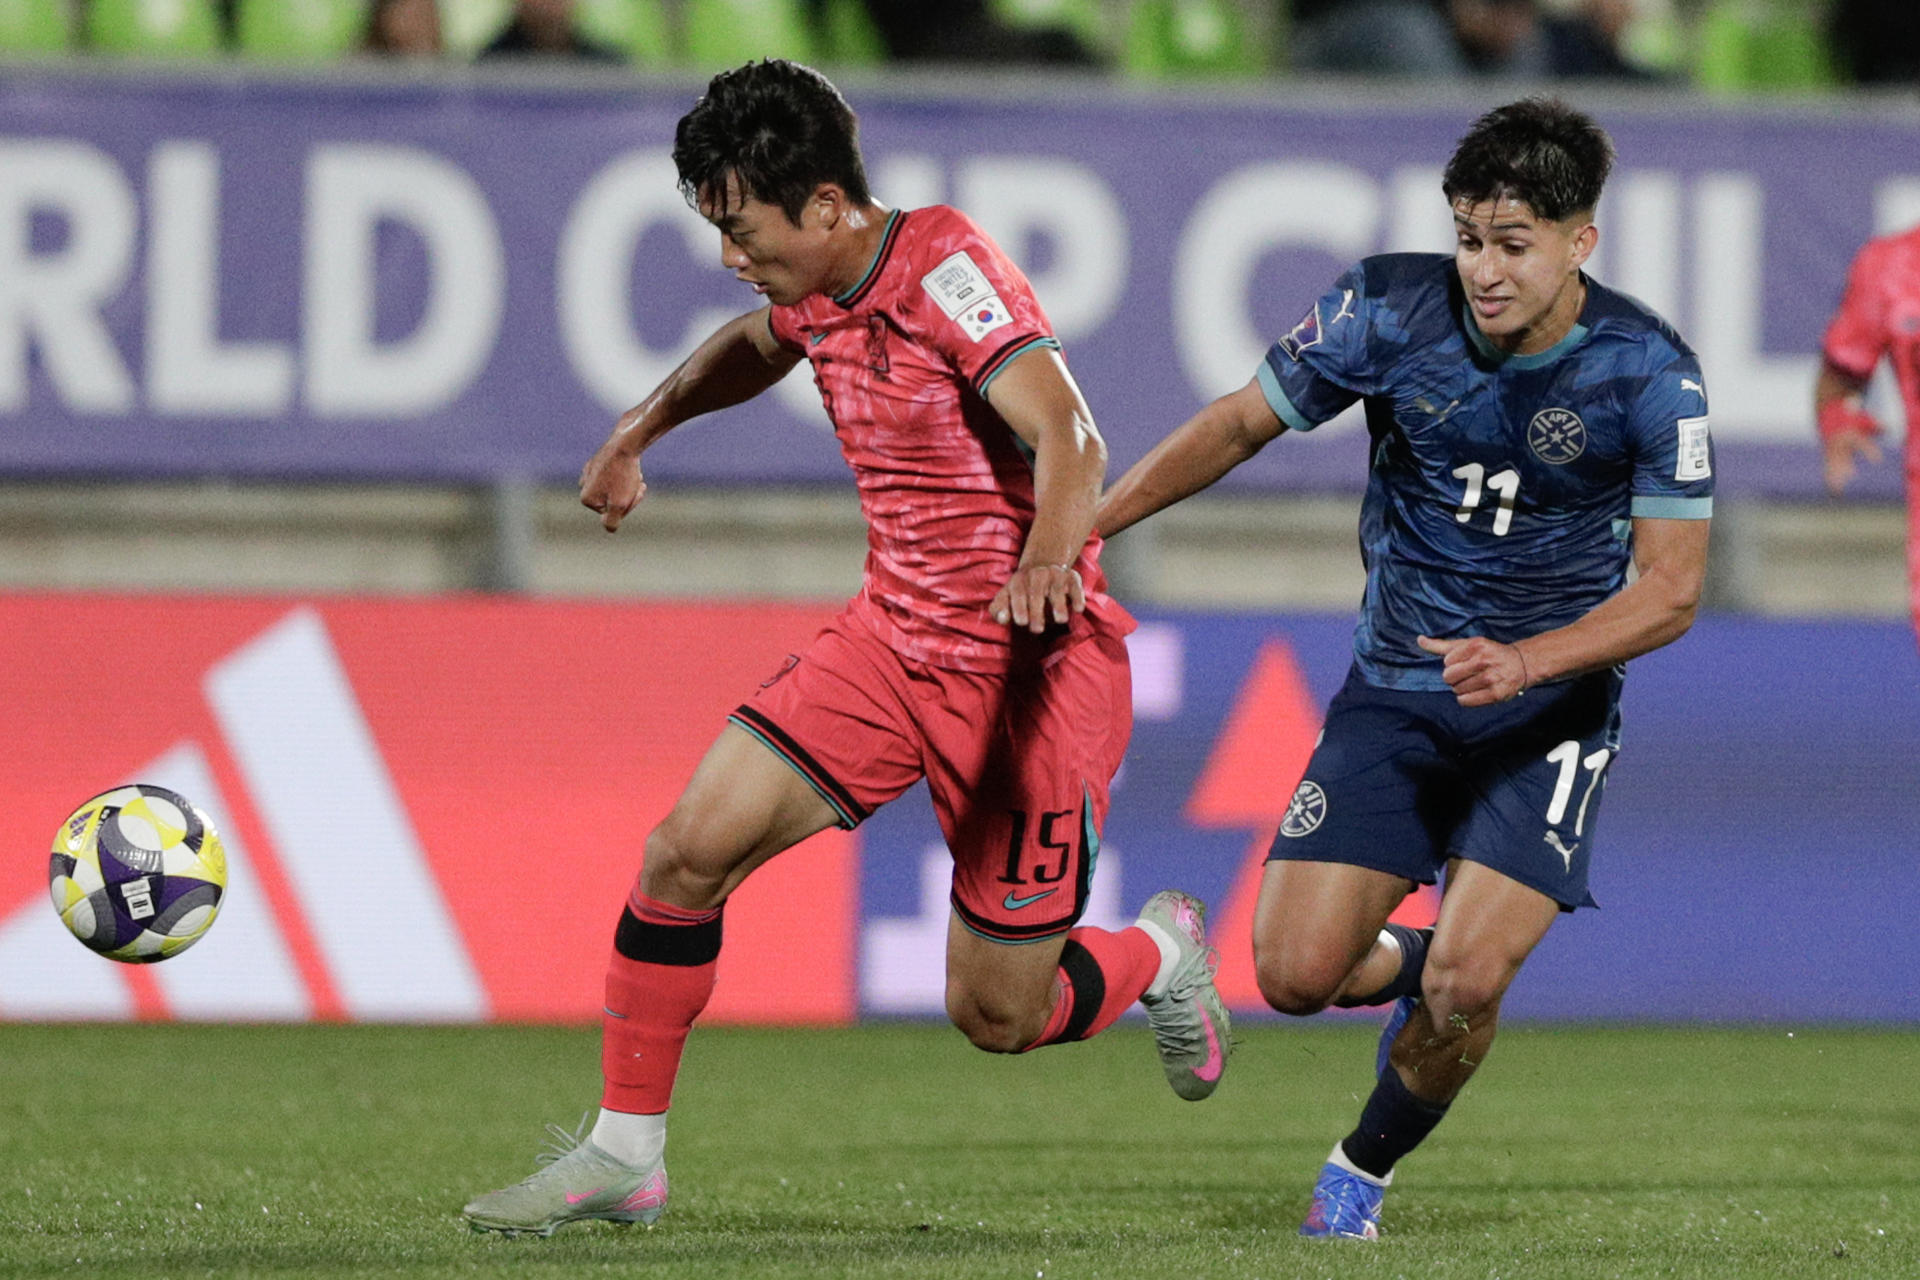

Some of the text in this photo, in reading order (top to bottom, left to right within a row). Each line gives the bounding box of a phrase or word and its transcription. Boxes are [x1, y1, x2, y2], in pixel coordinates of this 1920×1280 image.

[555, 143, 1134, 432] CP
[1549, 412, 1568, 423] APF
[1452, 462, 1520, 536] 11
[1546, 740, 1610, 837] 11
[996, 809, 1074, 884] 15
